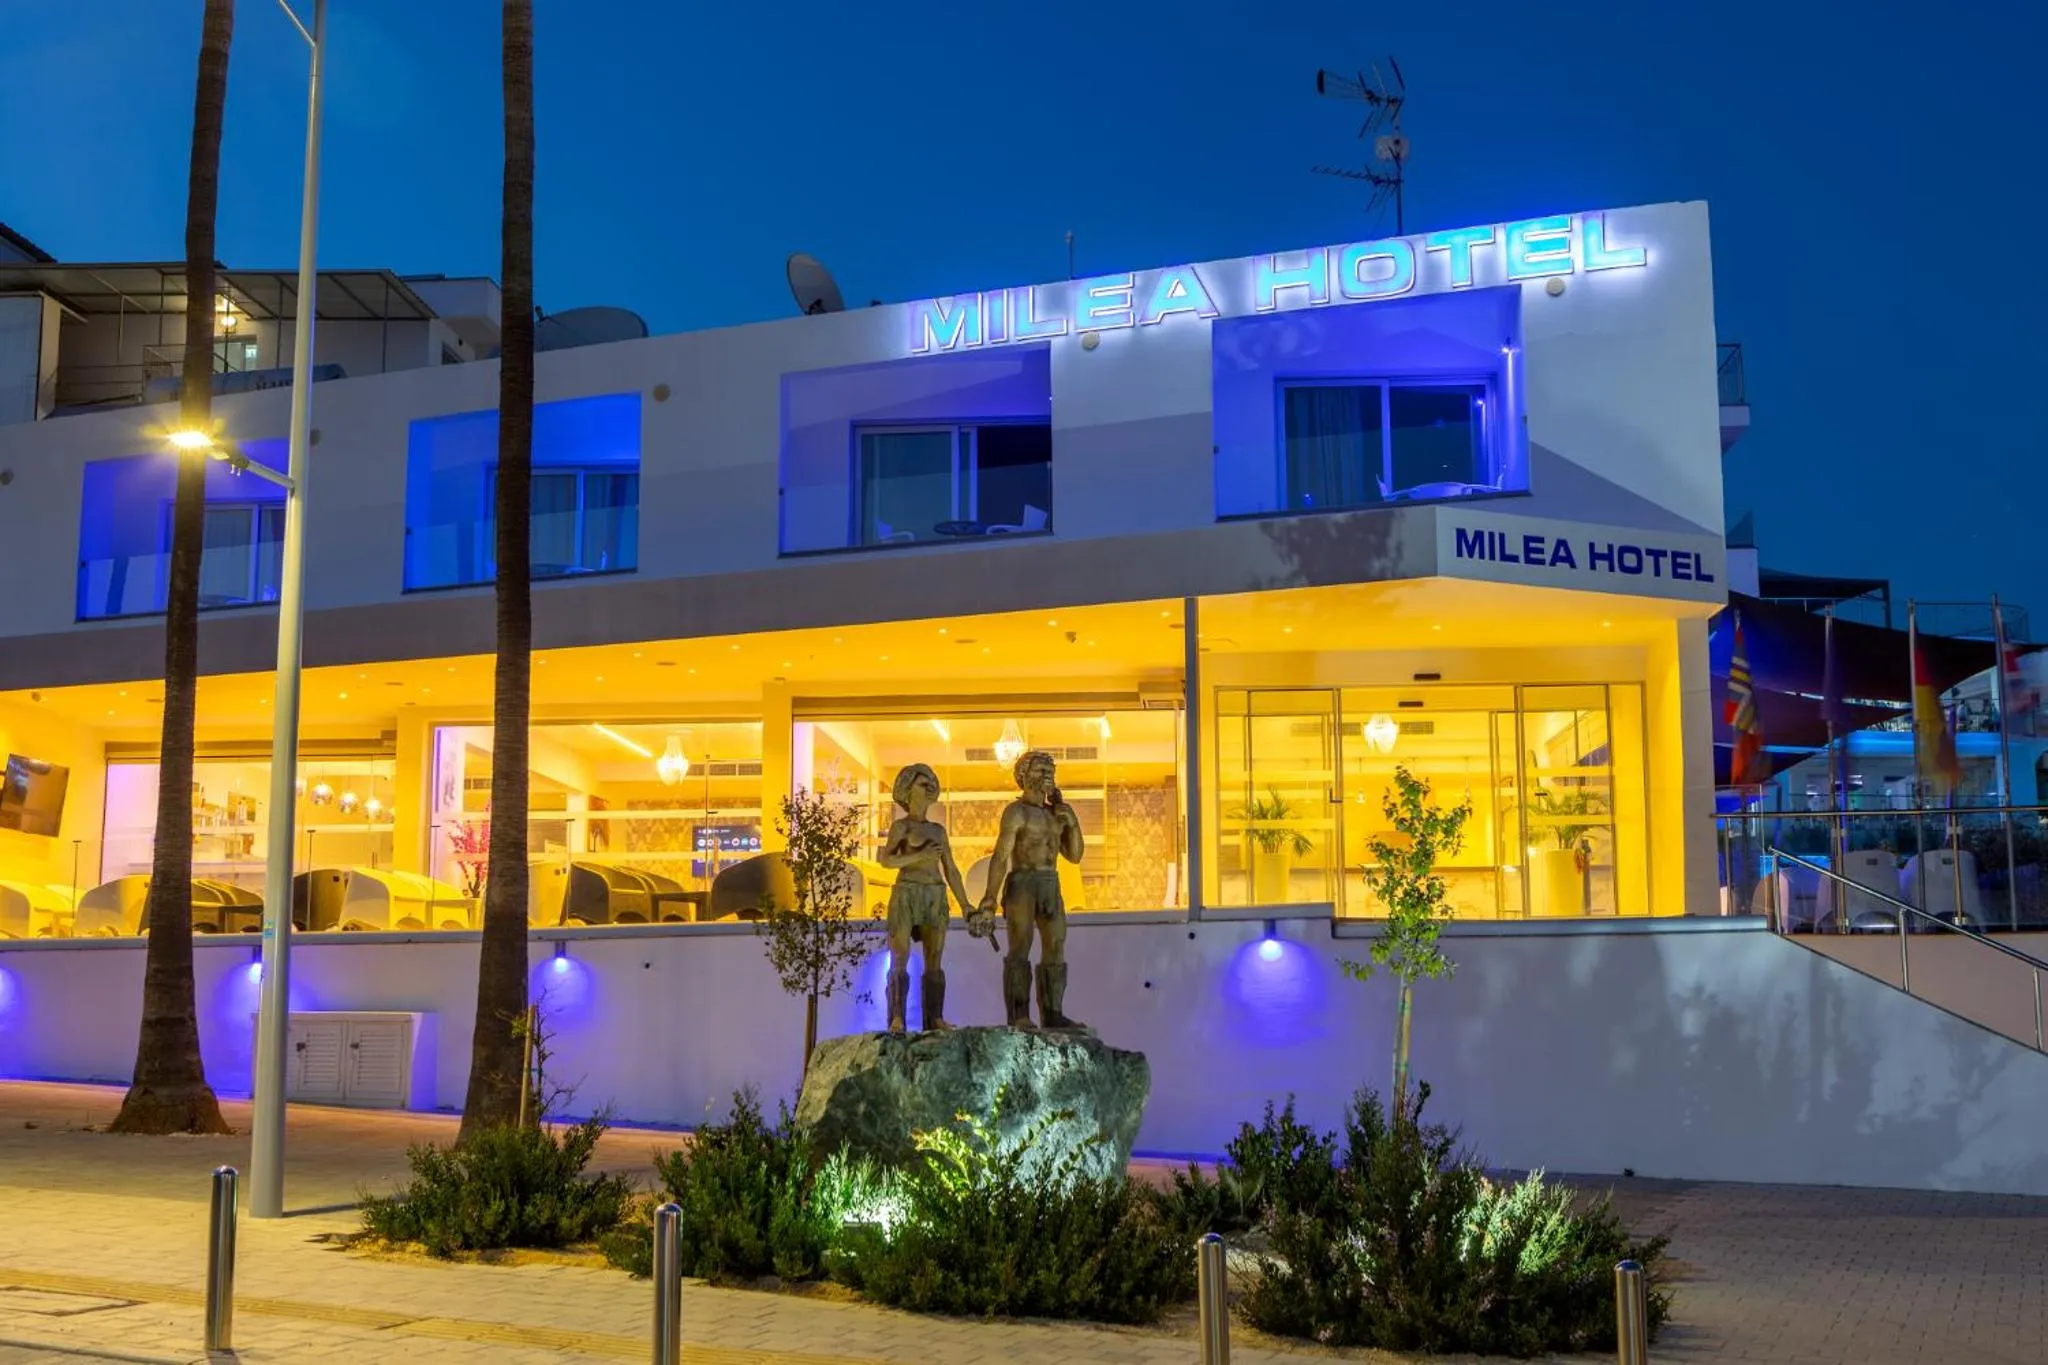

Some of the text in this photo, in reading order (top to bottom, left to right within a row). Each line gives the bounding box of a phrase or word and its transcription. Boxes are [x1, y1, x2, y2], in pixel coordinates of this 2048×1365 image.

[909, 211, 1647, 353] MILEA HOTEL
[1455, 527, 1715, 583] MILEA HOTEL
